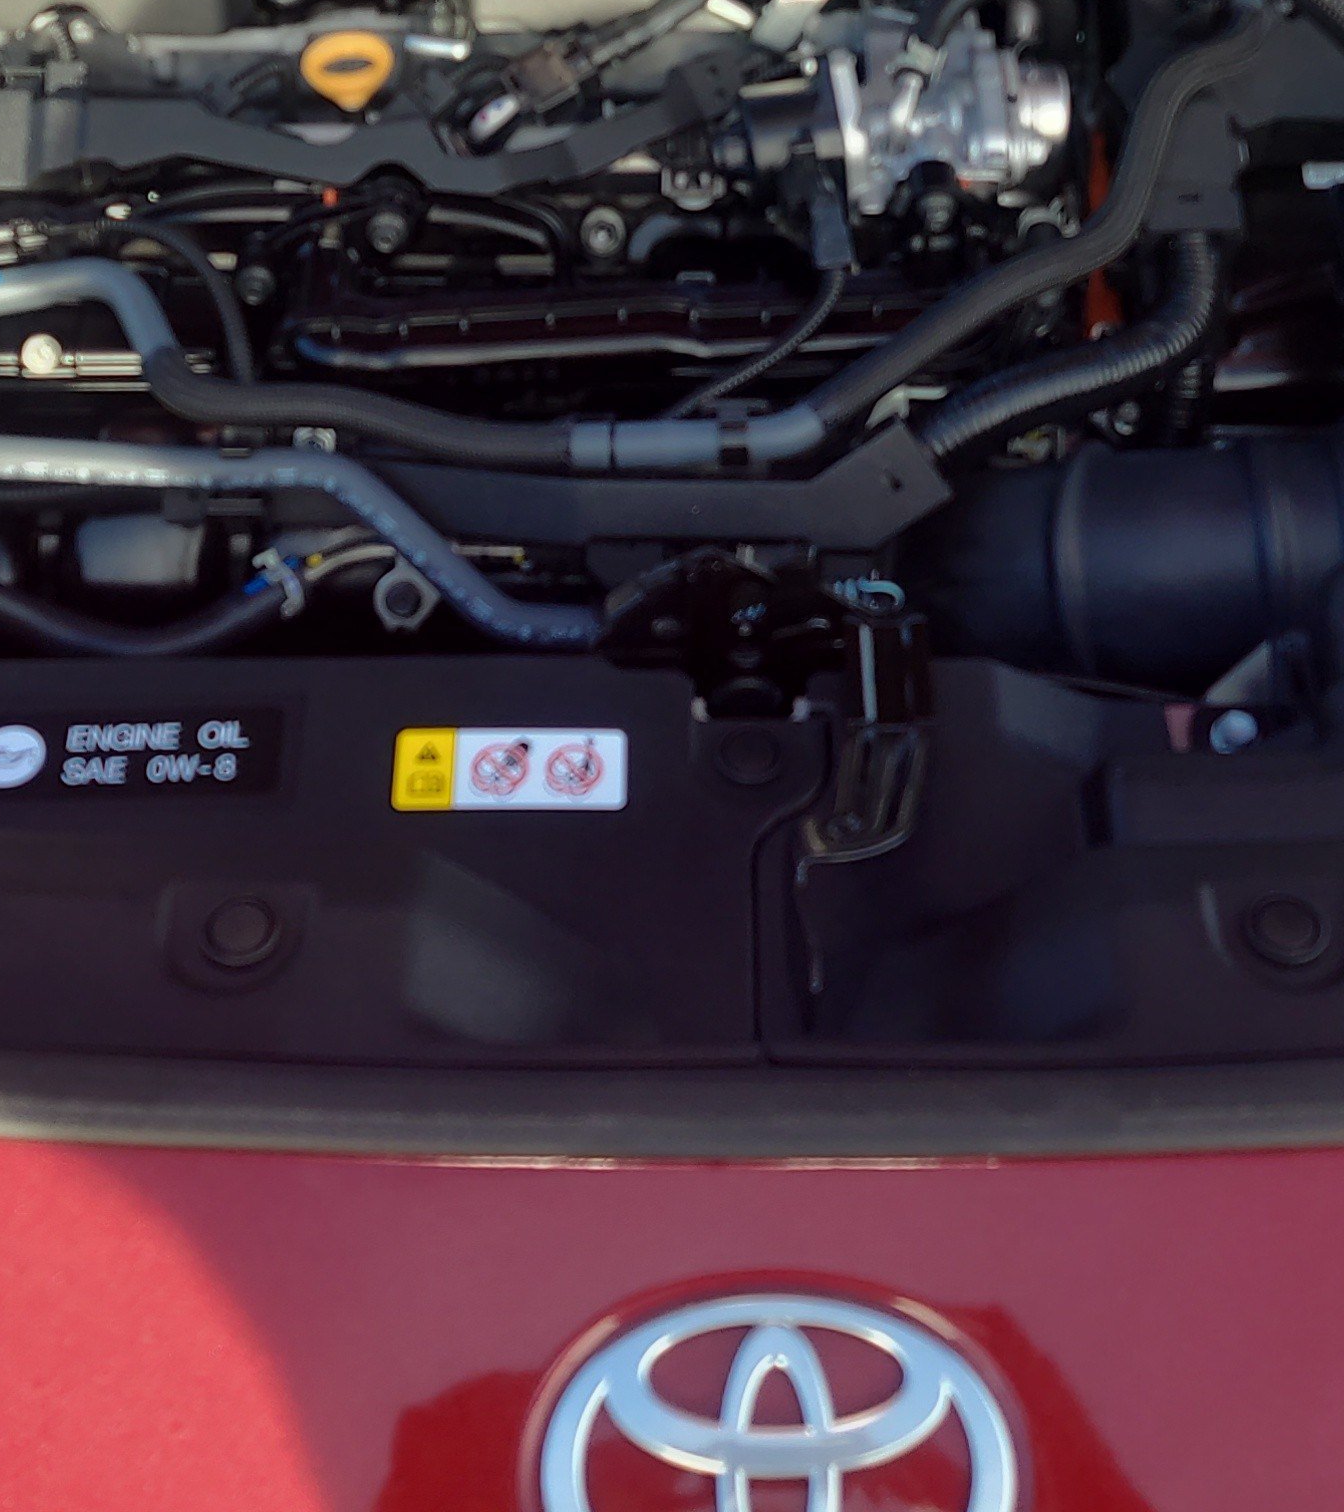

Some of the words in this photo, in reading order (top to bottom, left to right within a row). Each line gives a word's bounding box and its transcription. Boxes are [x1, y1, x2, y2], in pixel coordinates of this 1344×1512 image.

[65, 721, 182, 753] ENGINE
[197, 719, 251, 750] OIL
[60, 755, 129, 786] SAE
